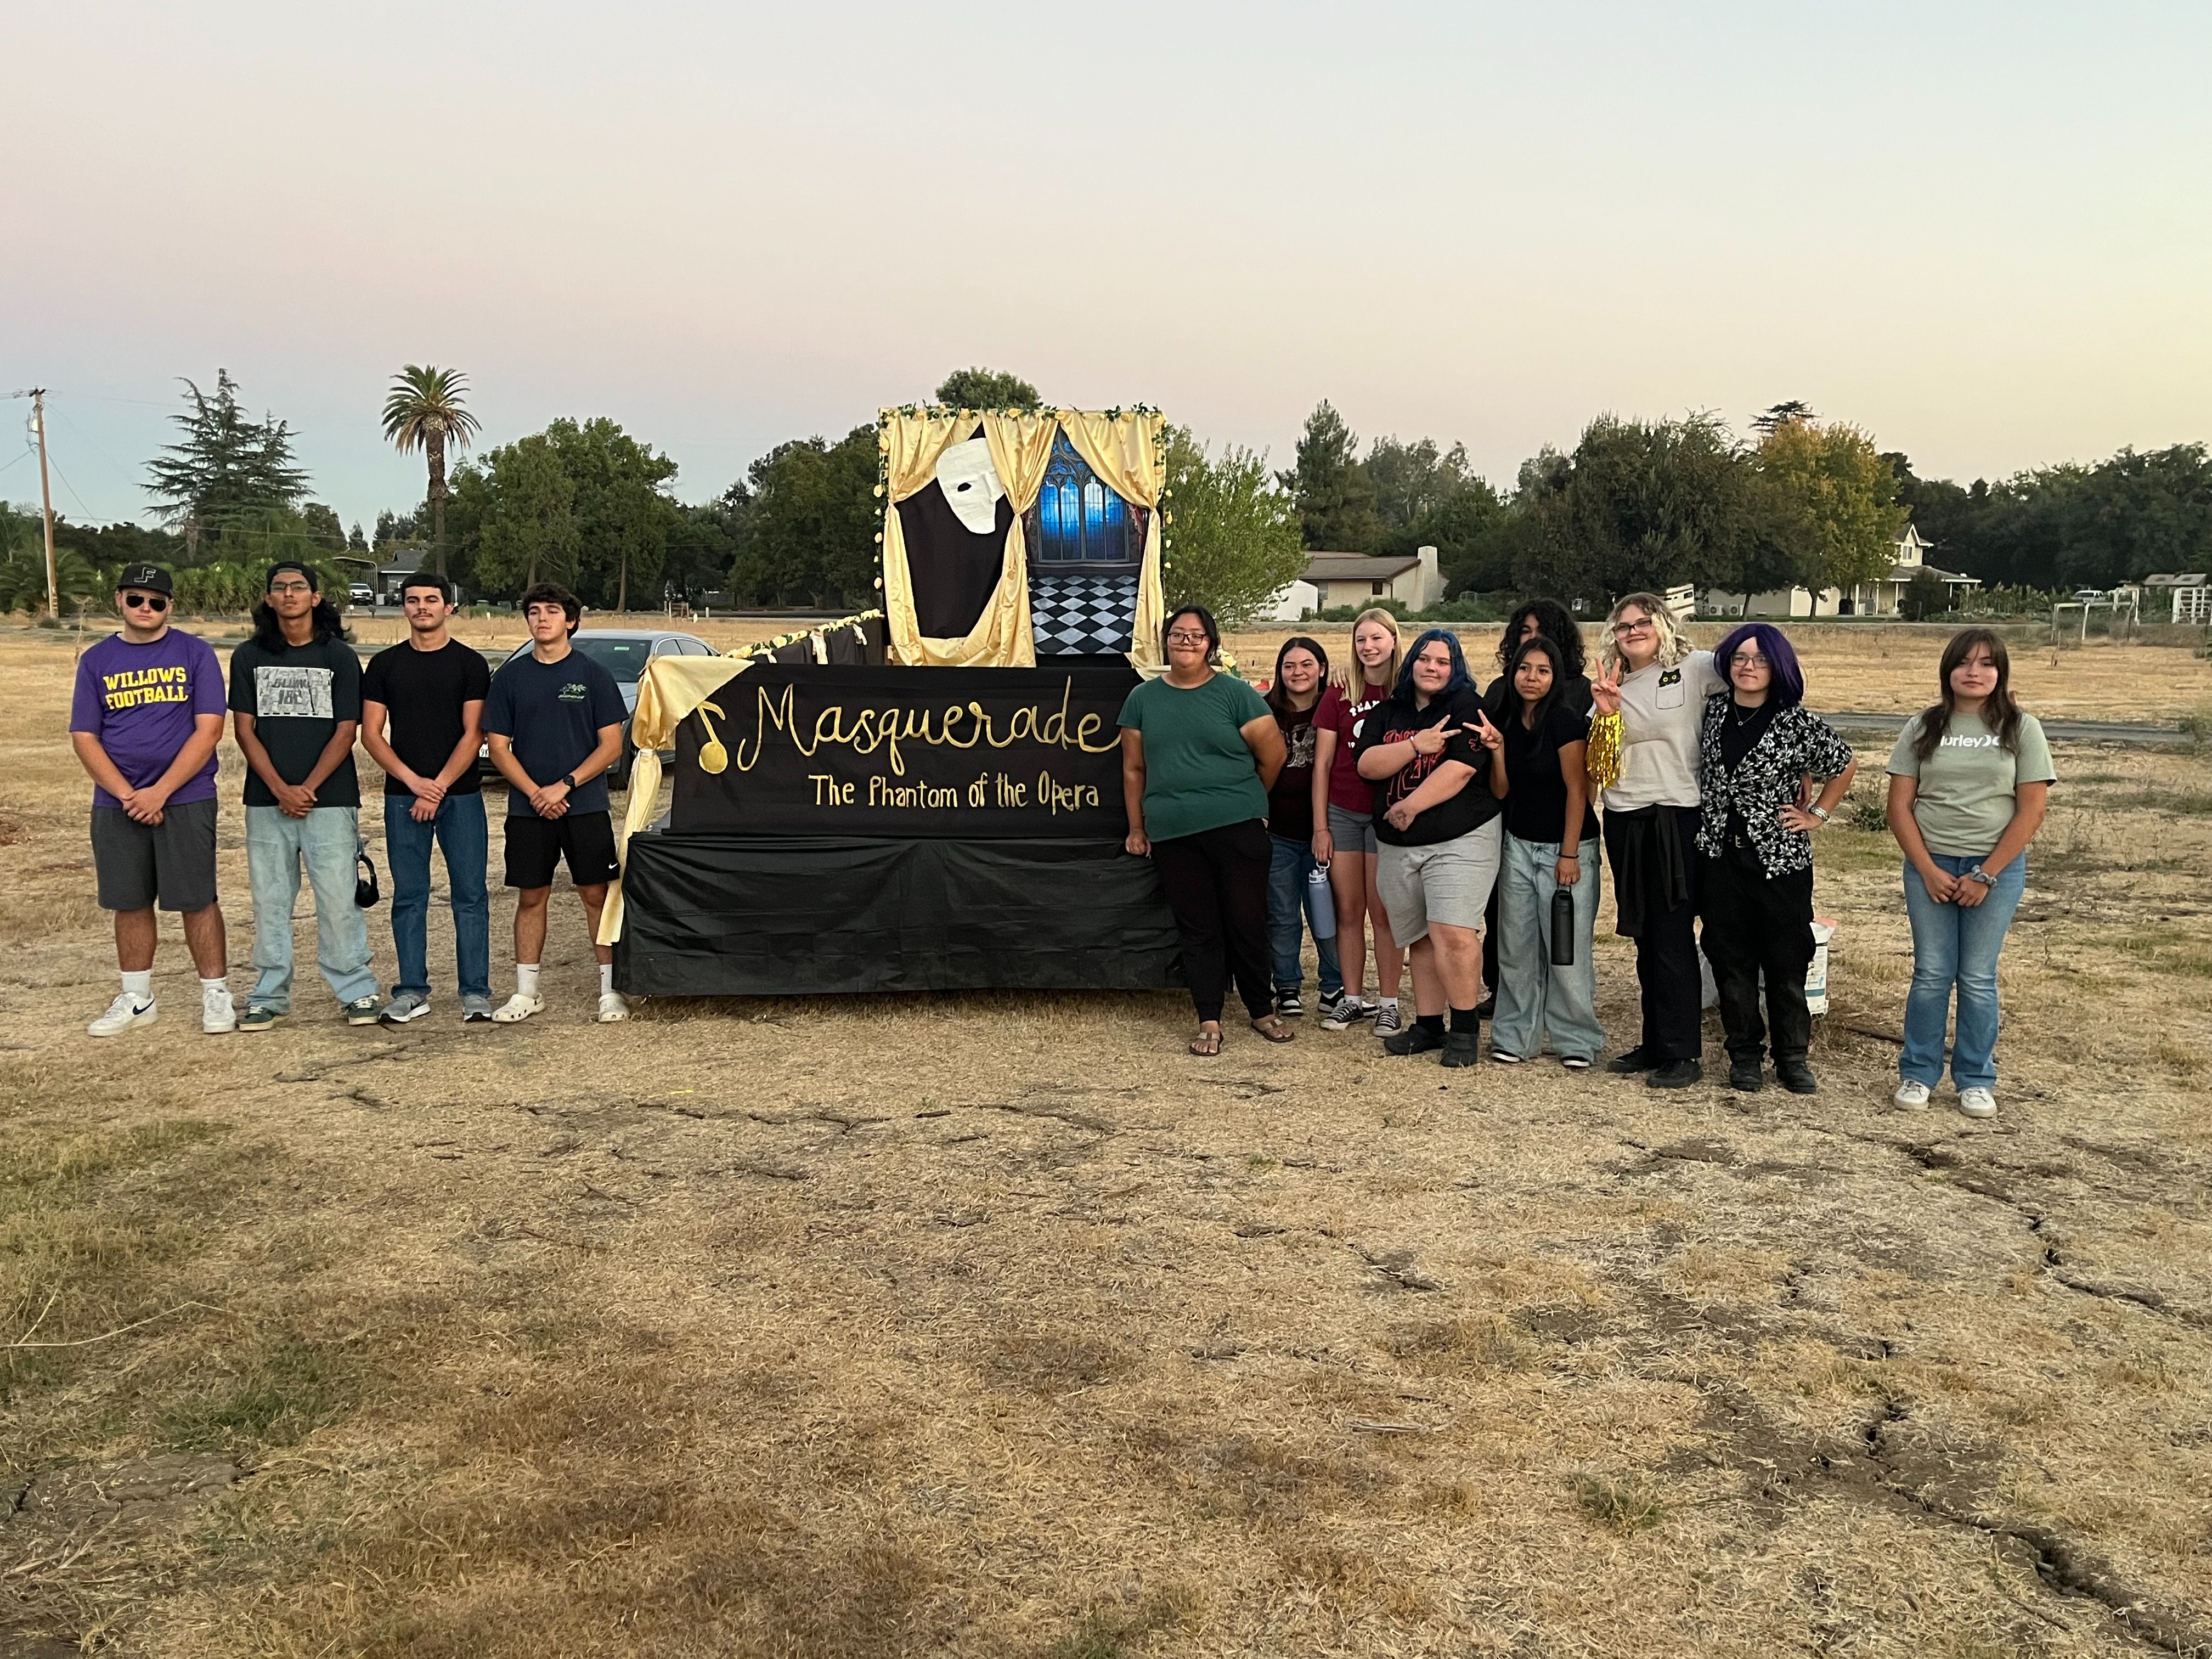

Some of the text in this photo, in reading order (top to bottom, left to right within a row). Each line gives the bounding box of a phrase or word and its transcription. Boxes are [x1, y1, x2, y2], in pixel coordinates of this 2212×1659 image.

[103, 667, 187, 691] WILLOWS
[105, 685, 189, 710] FOOTBALL
[737, 675, 1122, 776] Masquerade
[808, 770, 1099, 815] The Phantom of the Opera
